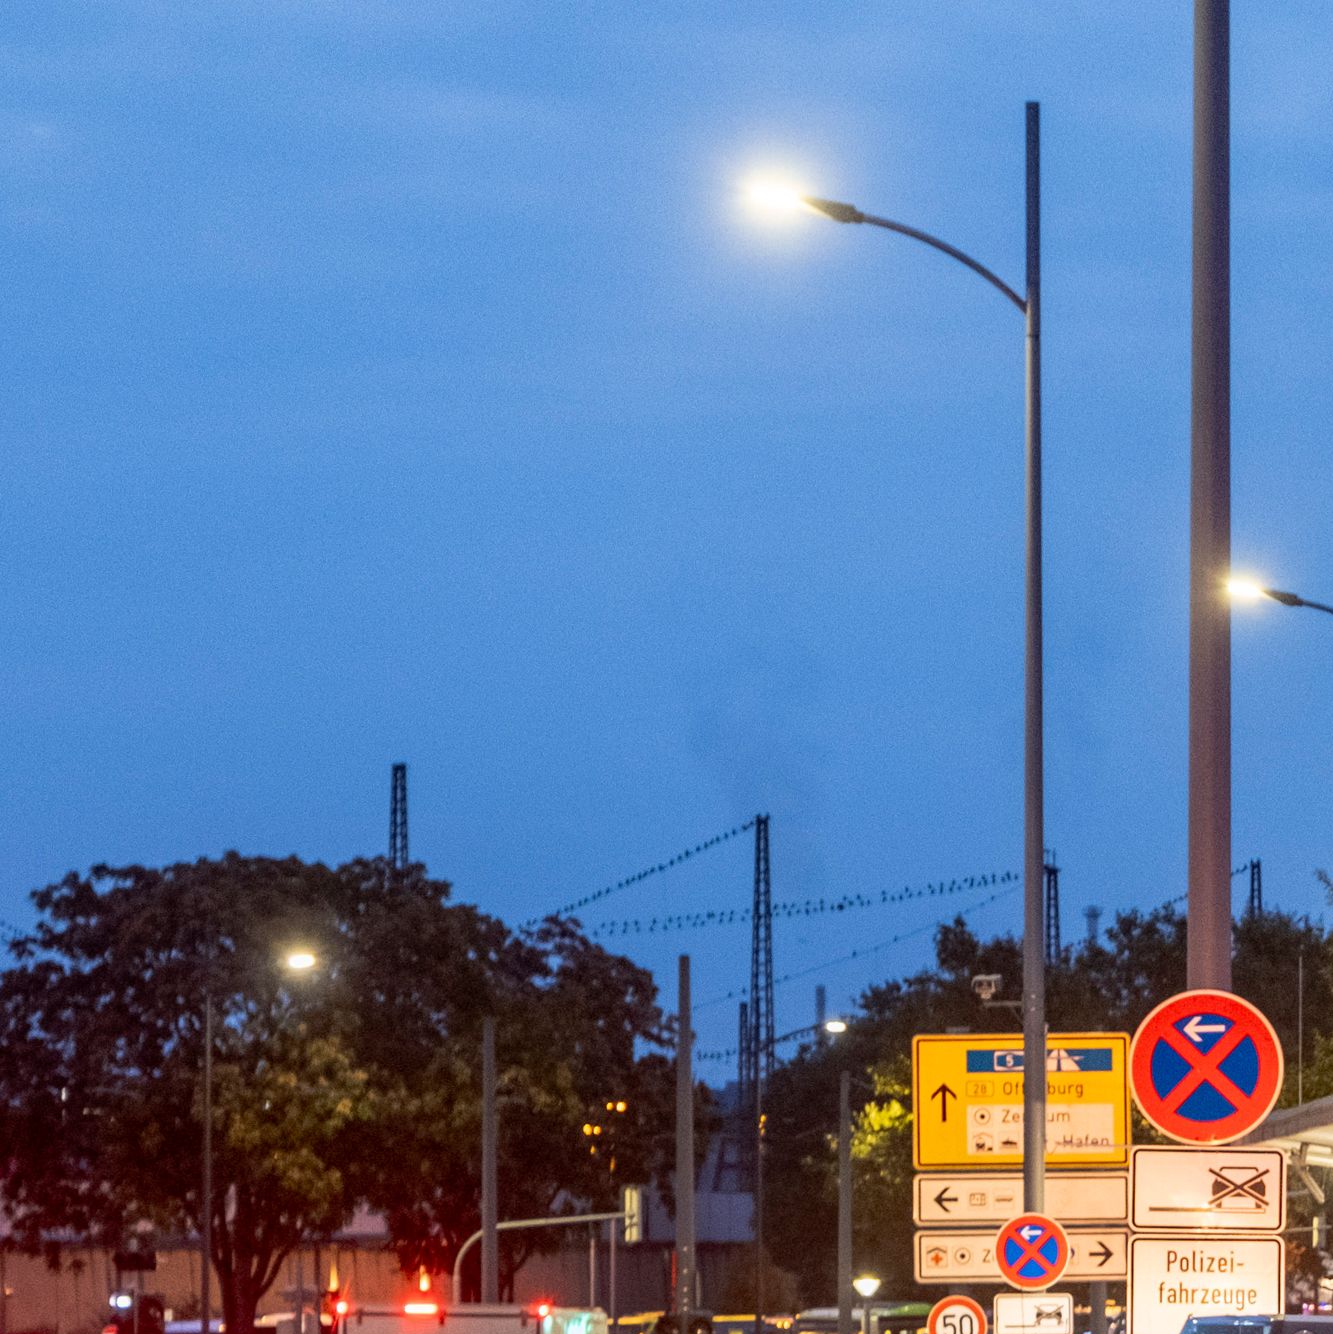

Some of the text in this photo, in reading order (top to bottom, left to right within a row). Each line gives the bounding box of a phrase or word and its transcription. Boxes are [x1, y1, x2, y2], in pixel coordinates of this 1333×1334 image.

[1005, 1054, 1014, 1067] 5
[973, 1081, 1084, 1098] 28 Ofburg
[1002, 1109, 1071, 1123] Zeum
[1166, 1250, 1245, 1273] Polizei-
[1158, 1281, 1257, 1311] fahrzeuge
